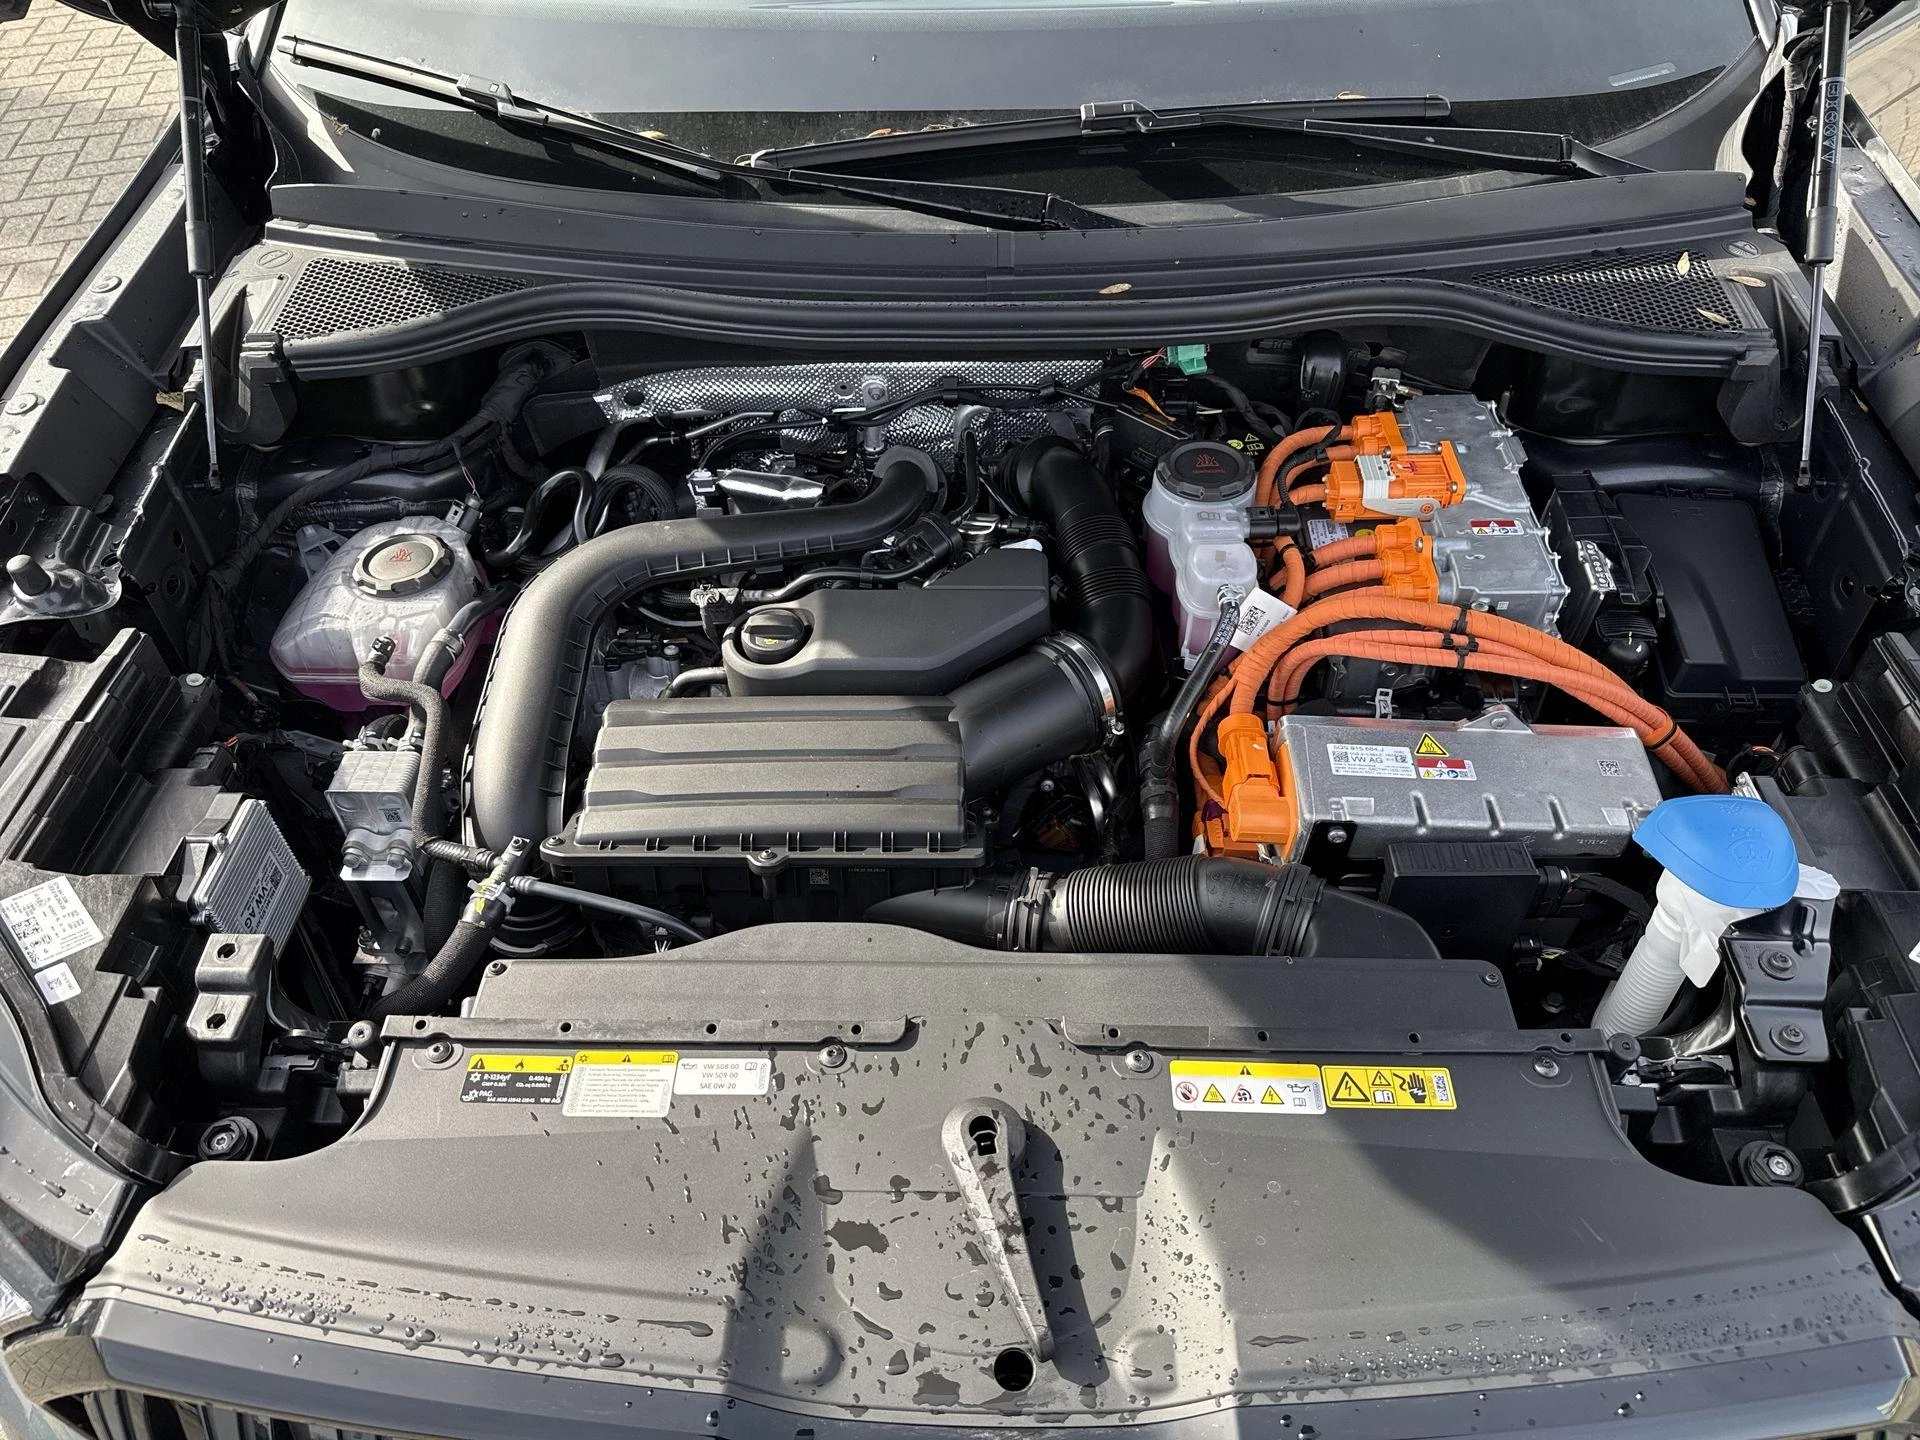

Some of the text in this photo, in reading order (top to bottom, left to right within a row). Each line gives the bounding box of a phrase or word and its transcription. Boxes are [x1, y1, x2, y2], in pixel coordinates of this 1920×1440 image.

[255, 886, 268, 909] VW
[244, 906, 256, 929] AG
[483, 1073, 512, 1081] R-1234yf
[544, 1075, 553, 1083] kg
